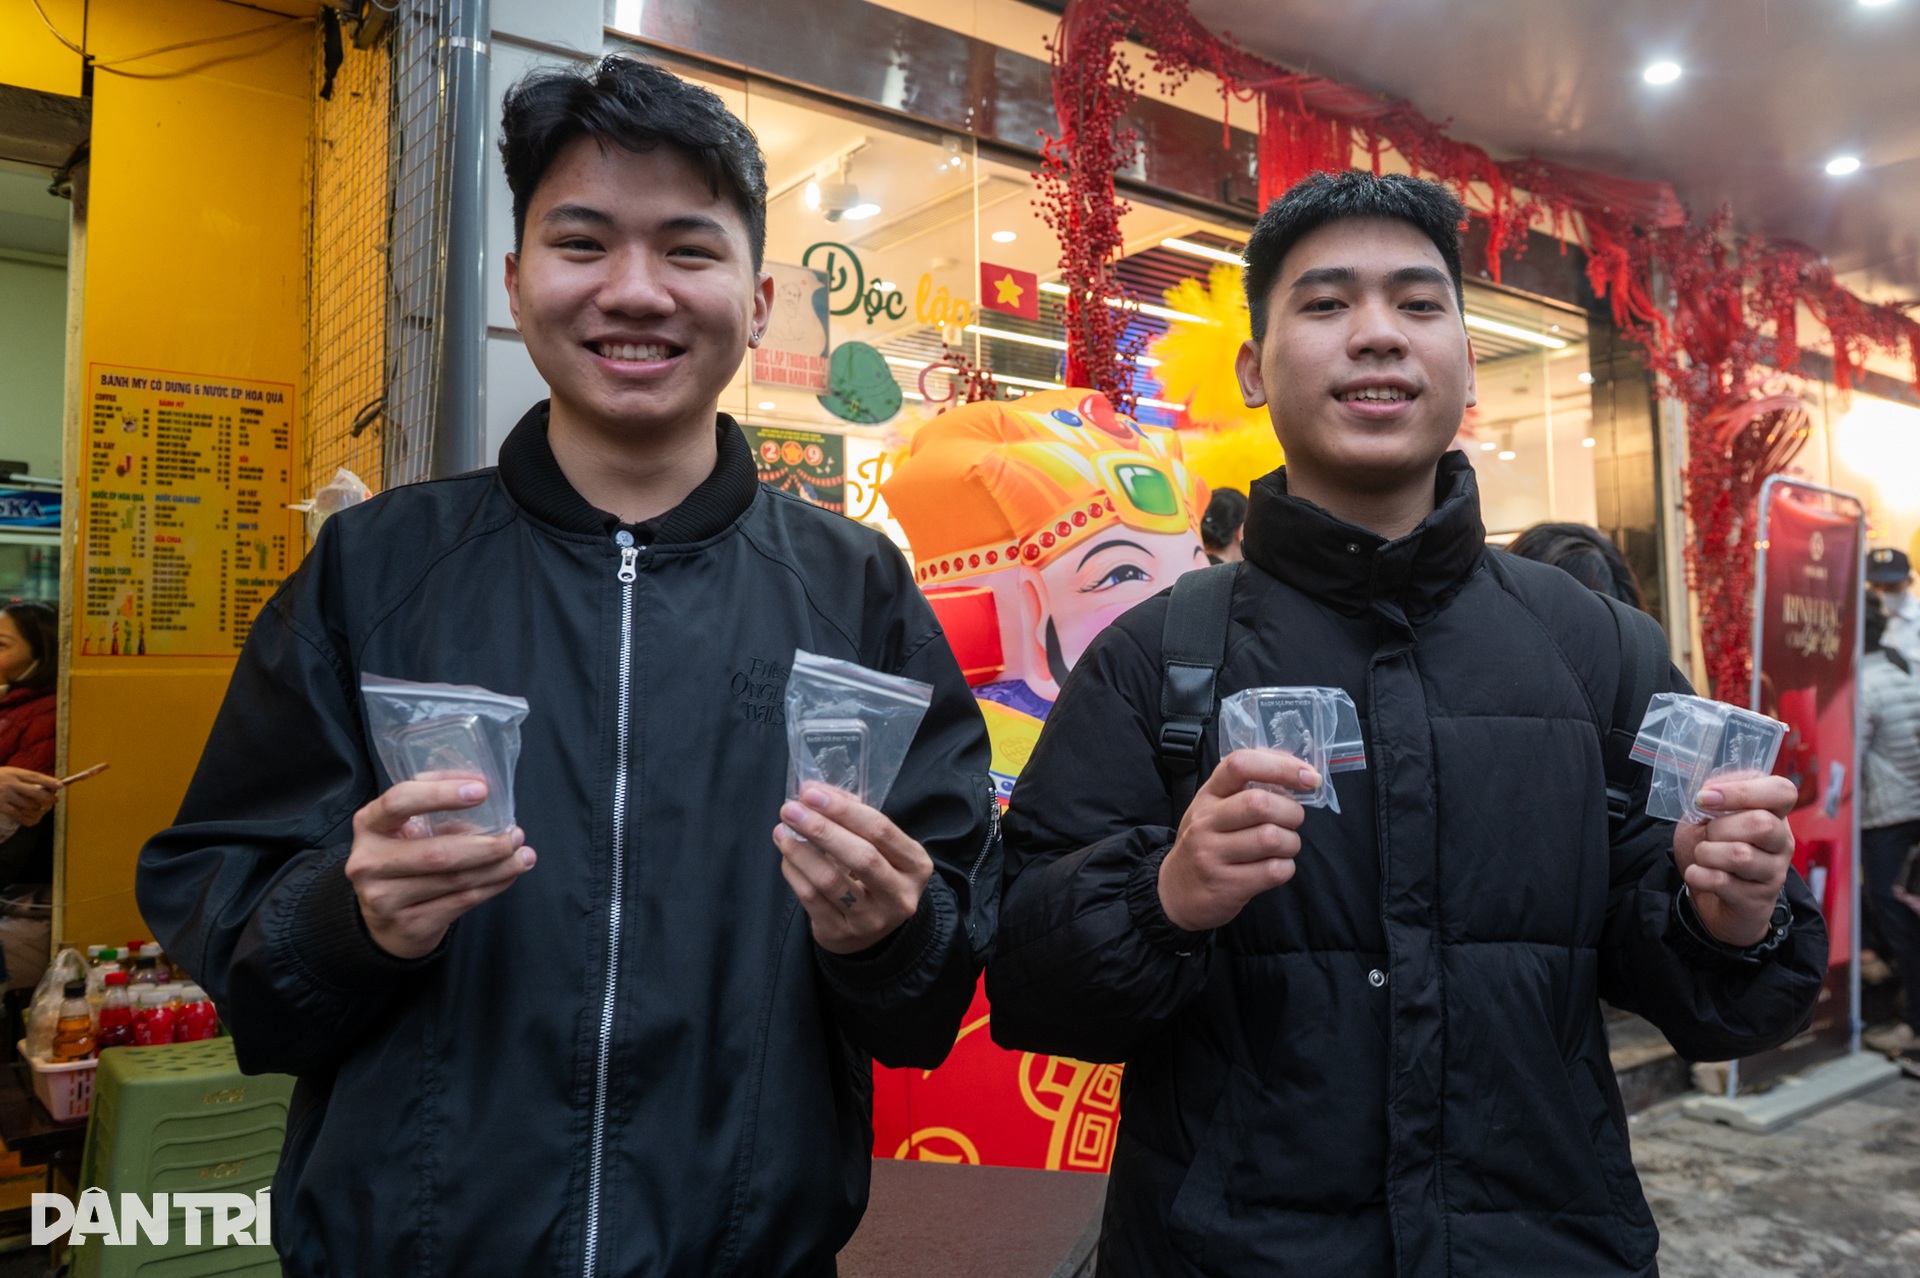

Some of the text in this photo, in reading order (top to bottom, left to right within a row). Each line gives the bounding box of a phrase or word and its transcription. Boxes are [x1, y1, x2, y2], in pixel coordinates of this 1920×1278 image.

[803, 242, 907, 324] Độc
[245, 389, 263, 401] HOA
[765, 443, 820, 462] 2 9
